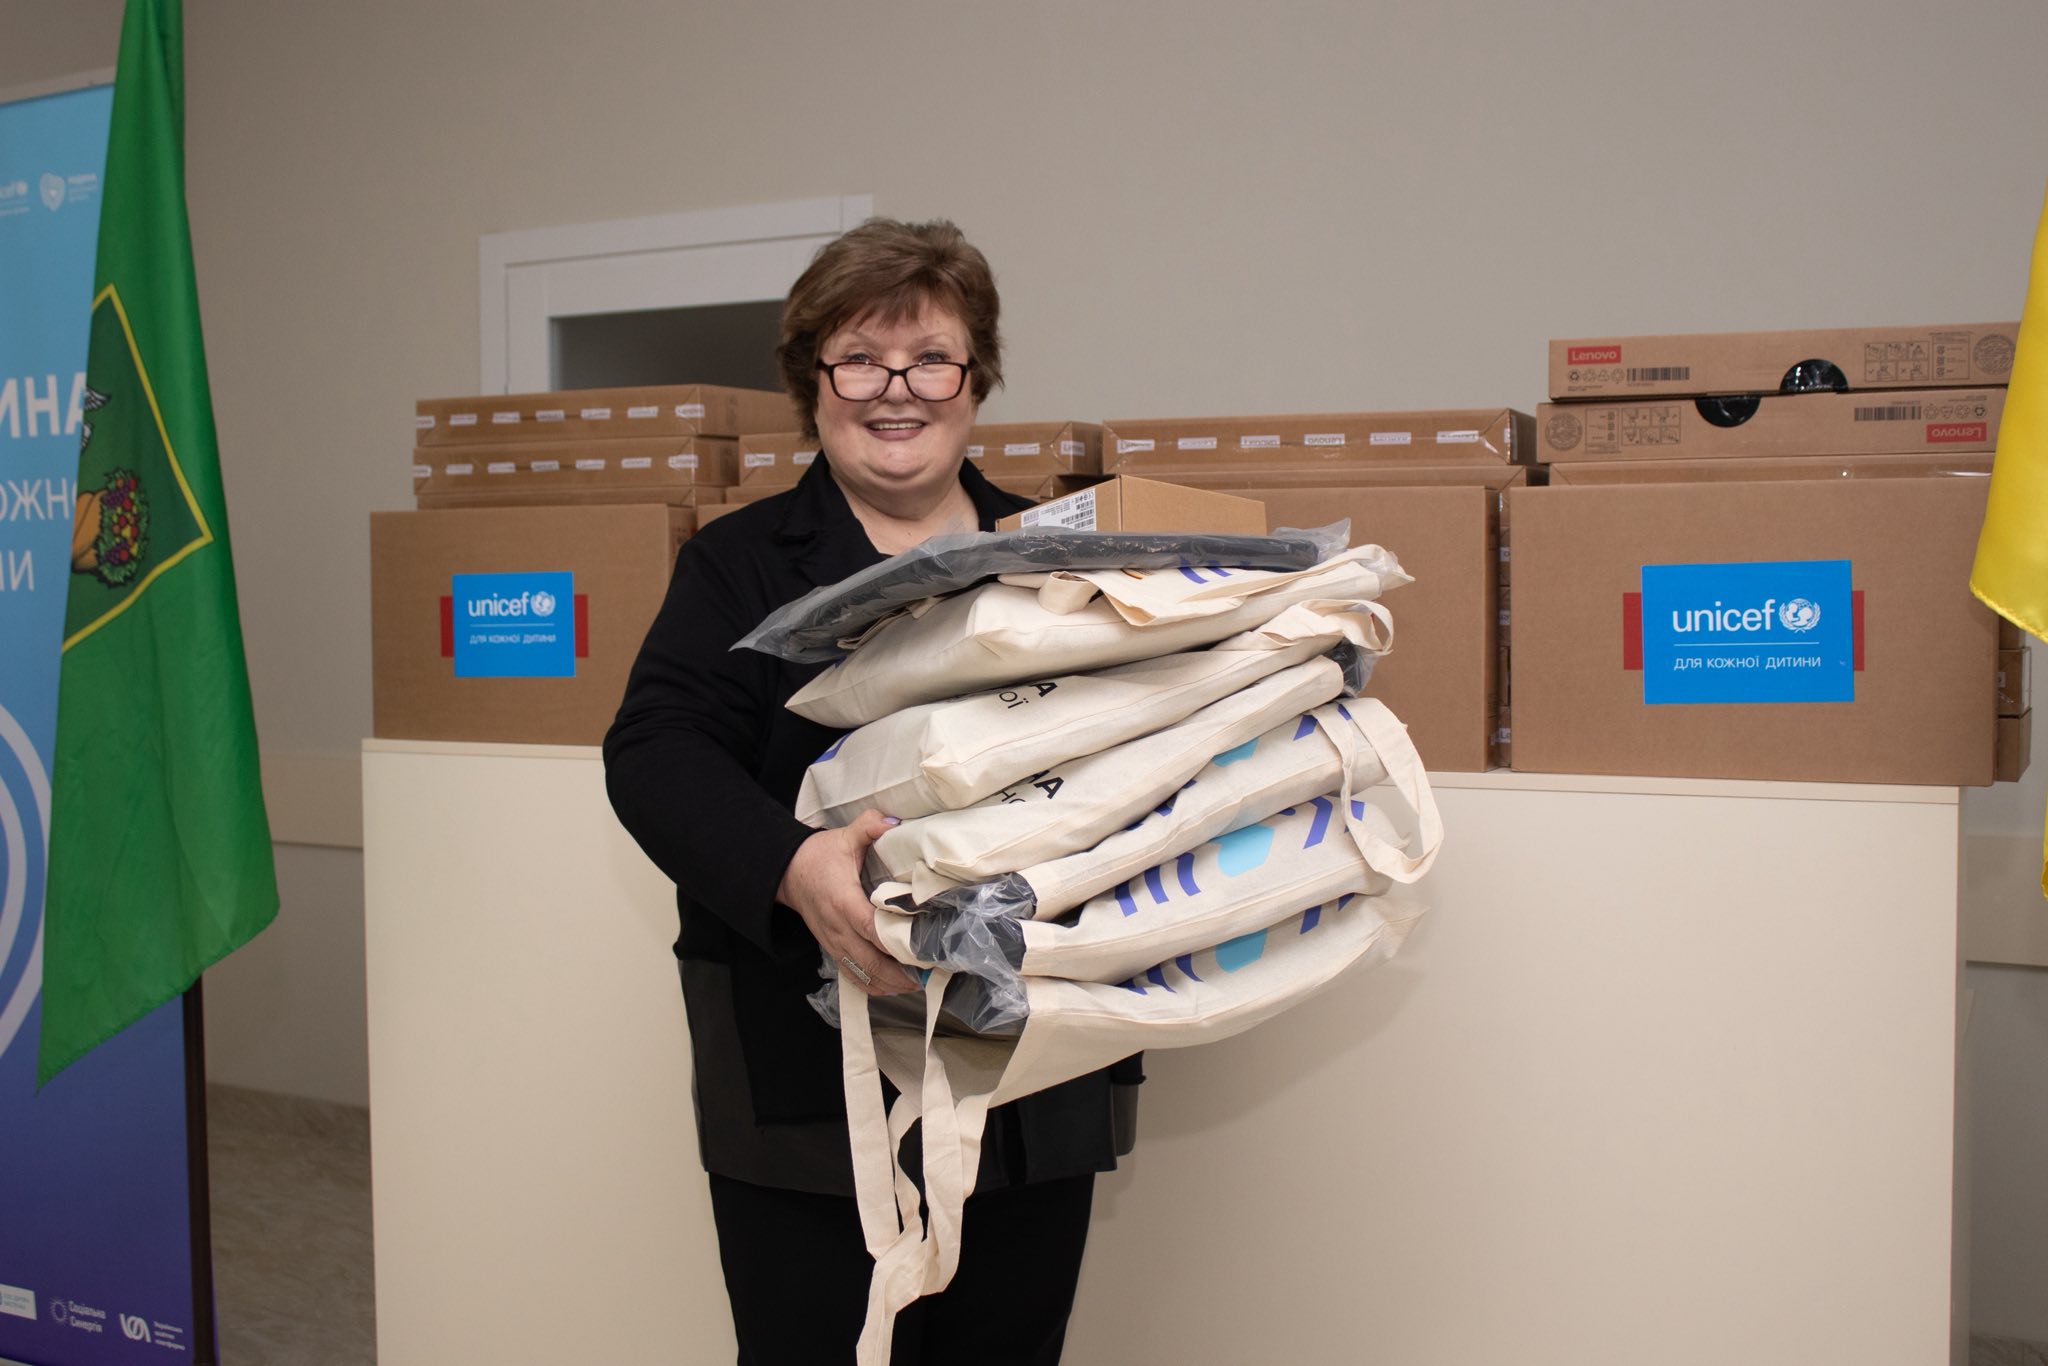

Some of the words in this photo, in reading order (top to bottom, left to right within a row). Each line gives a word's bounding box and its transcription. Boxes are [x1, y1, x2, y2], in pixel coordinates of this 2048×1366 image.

[1571, 349, 1617, 361] Lenovo
[1930, 426, 1982, 438] Lenovo
[468, 591, 530, 617] unicef
[1672, 598, 1776, 633] unicef
[1673, 656, 1703, 671] для
[1706, 654, 1760, 668] кожної
[1765, 656, 1821, 670] дитини
